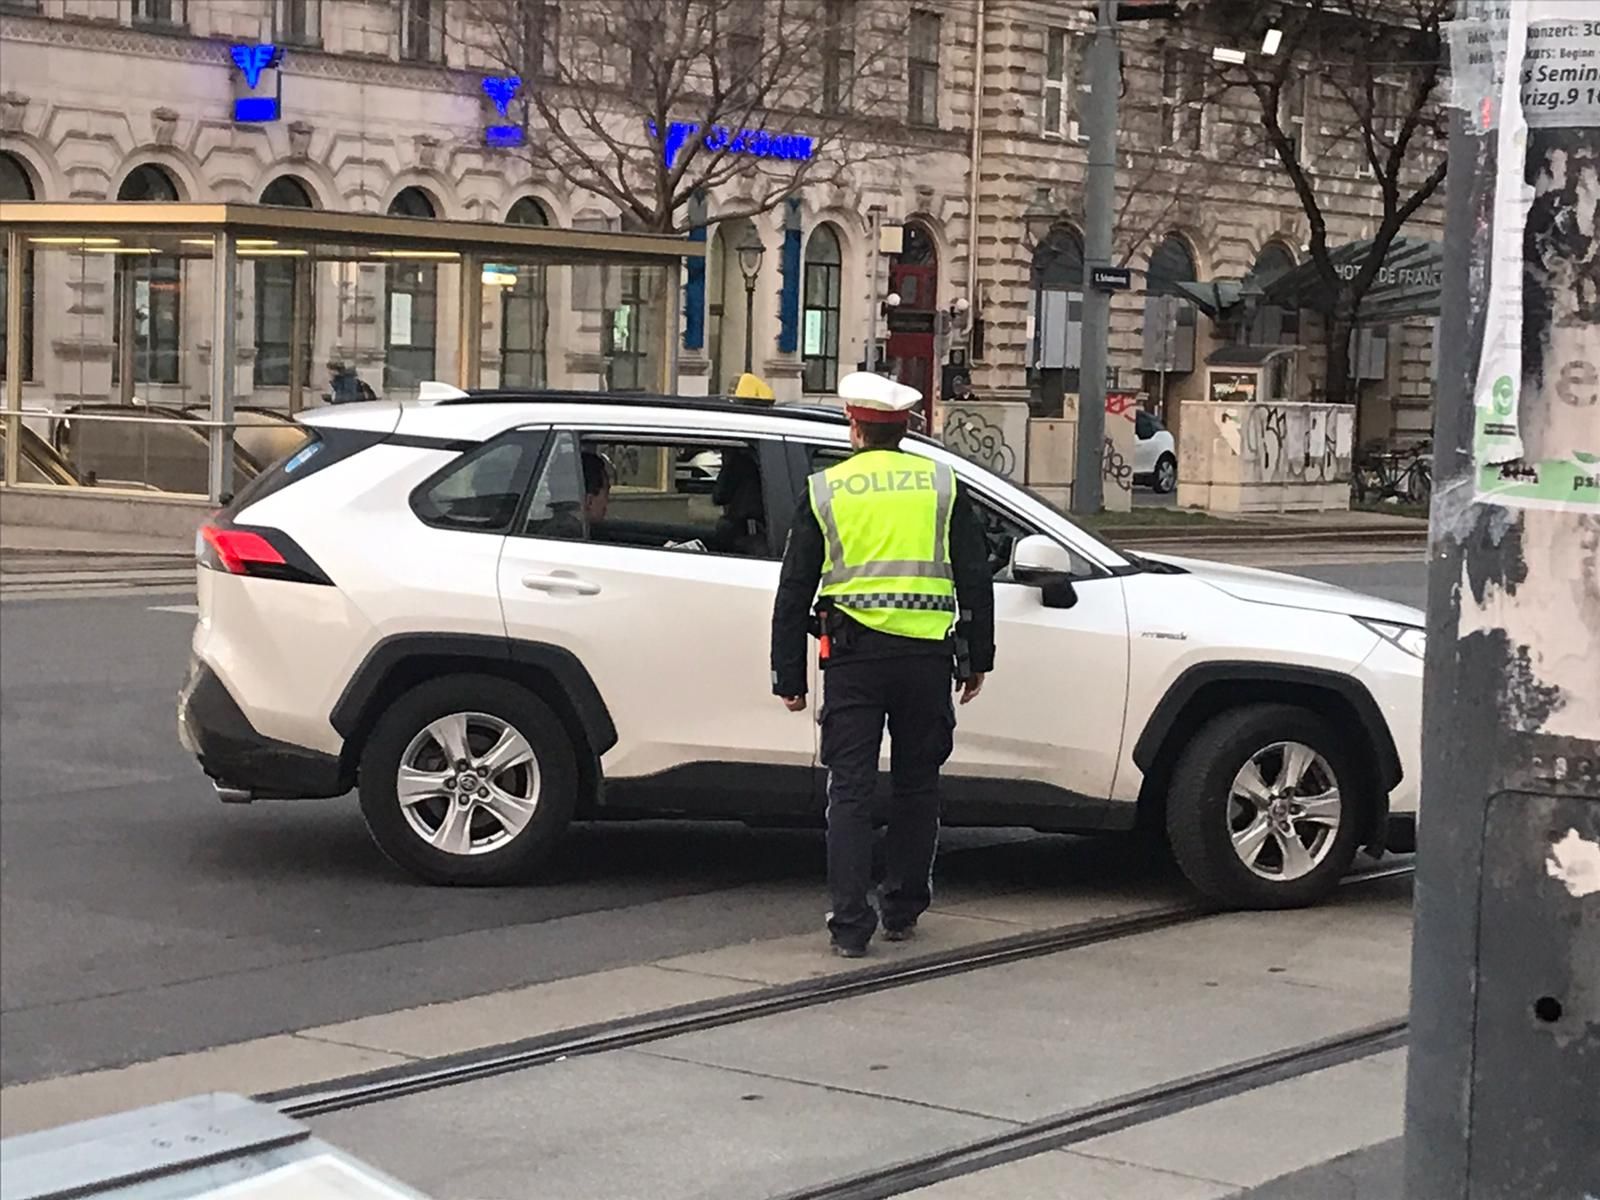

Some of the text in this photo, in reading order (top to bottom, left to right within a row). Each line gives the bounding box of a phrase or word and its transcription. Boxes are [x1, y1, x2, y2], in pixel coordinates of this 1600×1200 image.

[1536, 64, 1600, 82] Semin
[1333, 264, 1442, 287] HOT DE FRANC
